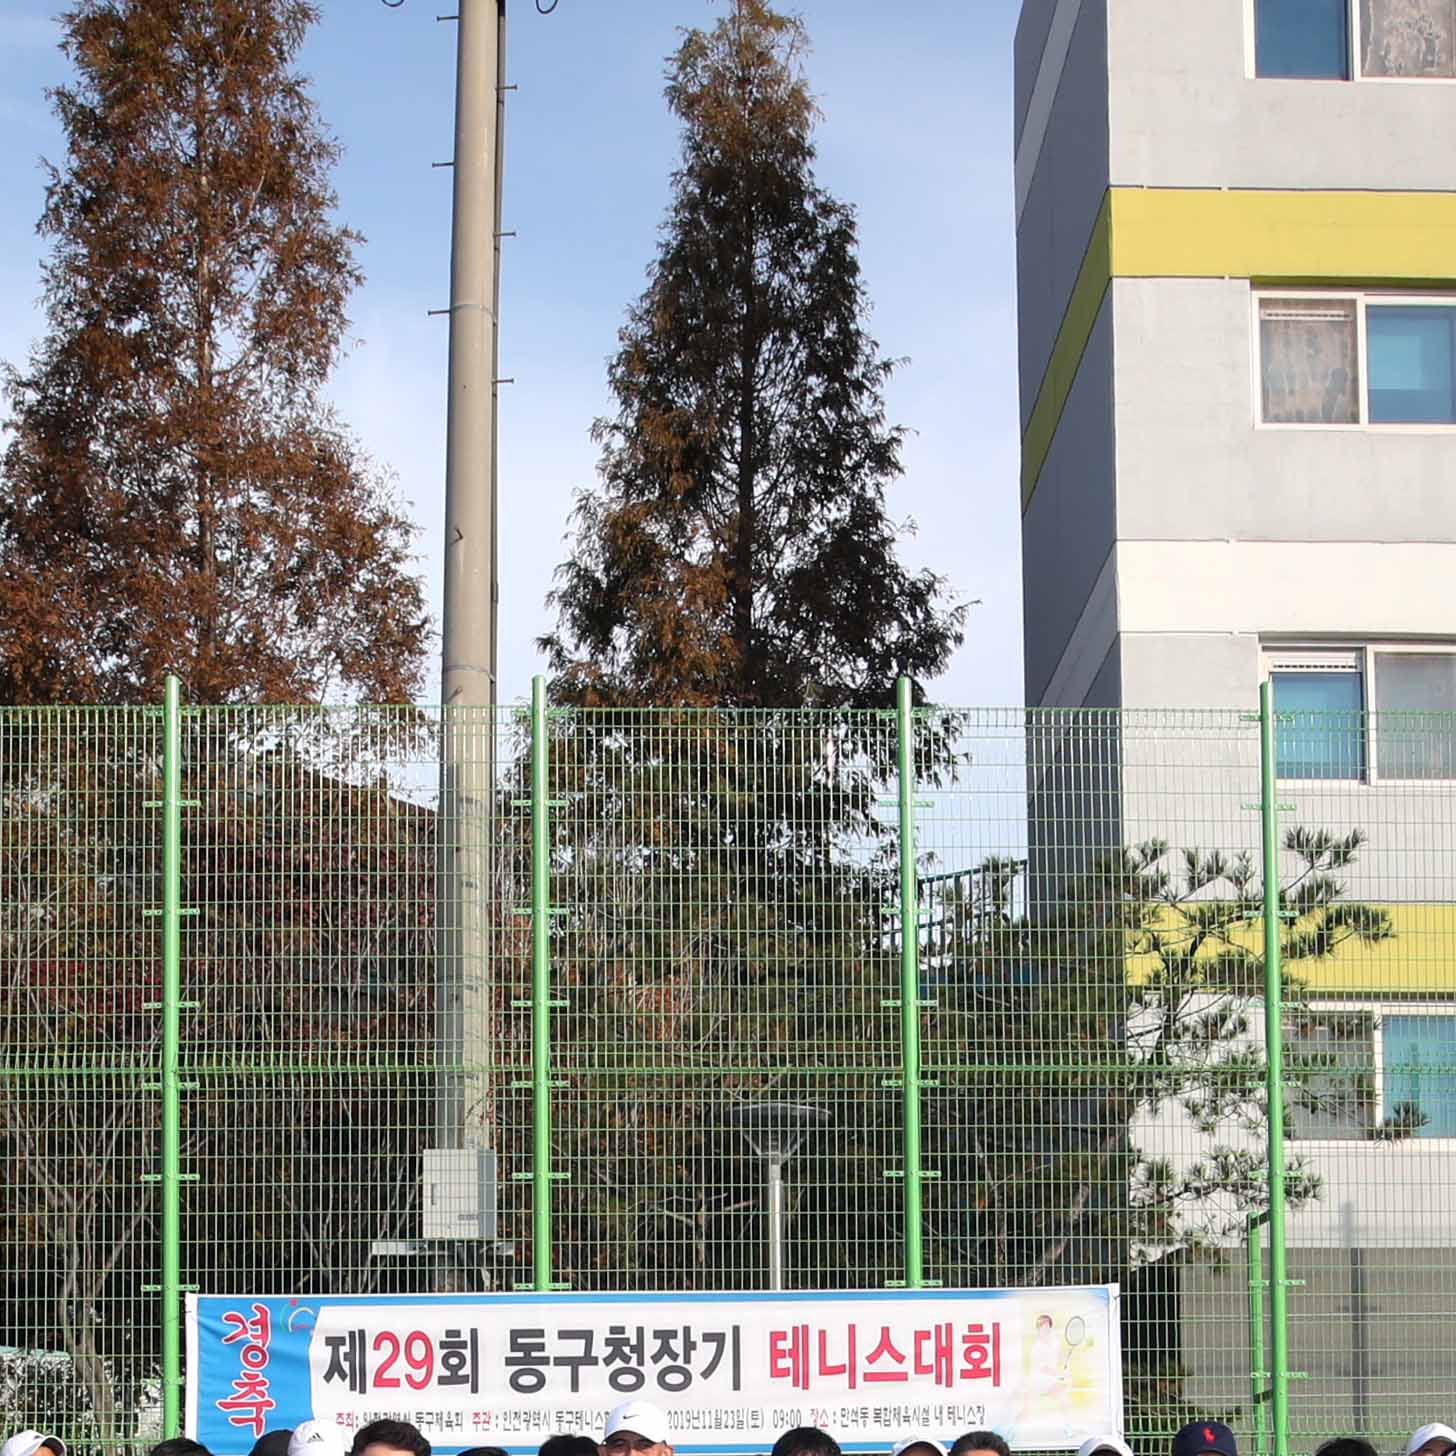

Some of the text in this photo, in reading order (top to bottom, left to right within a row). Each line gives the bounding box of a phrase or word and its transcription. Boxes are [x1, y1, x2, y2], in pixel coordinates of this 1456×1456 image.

[215, 1302, 276, 1437] 경축
[322, 1320, 1002, 1395] 제29회 동구청장기 테니스대회
[503, 1409, 551, 1432] 인천광역시
[772, 1408, 803, 1430] 09:00
